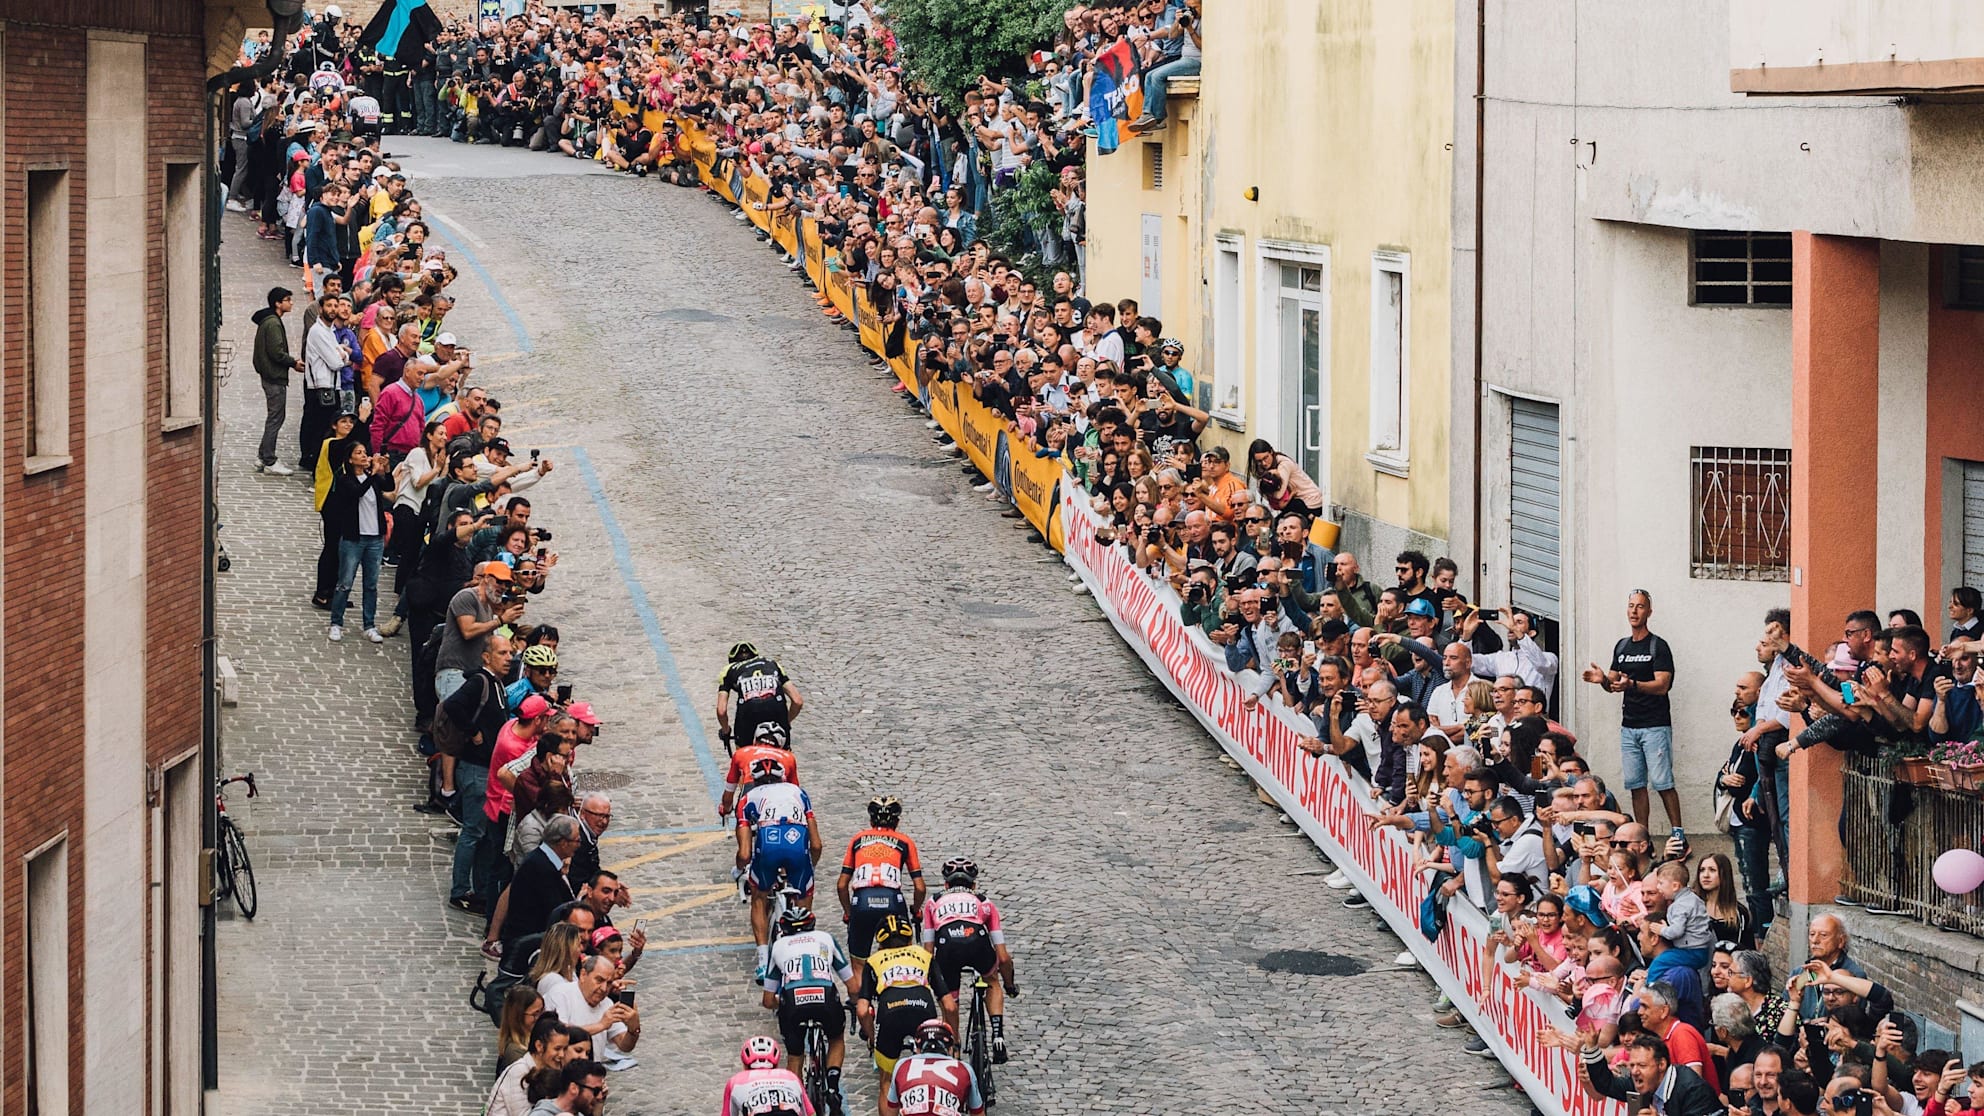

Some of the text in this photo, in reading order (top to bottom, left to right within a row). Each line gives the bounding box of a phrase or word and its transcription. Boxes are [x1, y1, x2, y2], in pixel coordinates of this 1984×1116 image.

[1014, 459, 1043, 507] Continental
[1106, 545, 1156, 644] SANGEMINI
[1148, 602, 1219, 717] SANGEMINI
[1217, 671, 1299, 796] SANGEMINI
[1299, 750, 1377, 882] SANGEMINI
[906, 1058, 959, 1087] K
